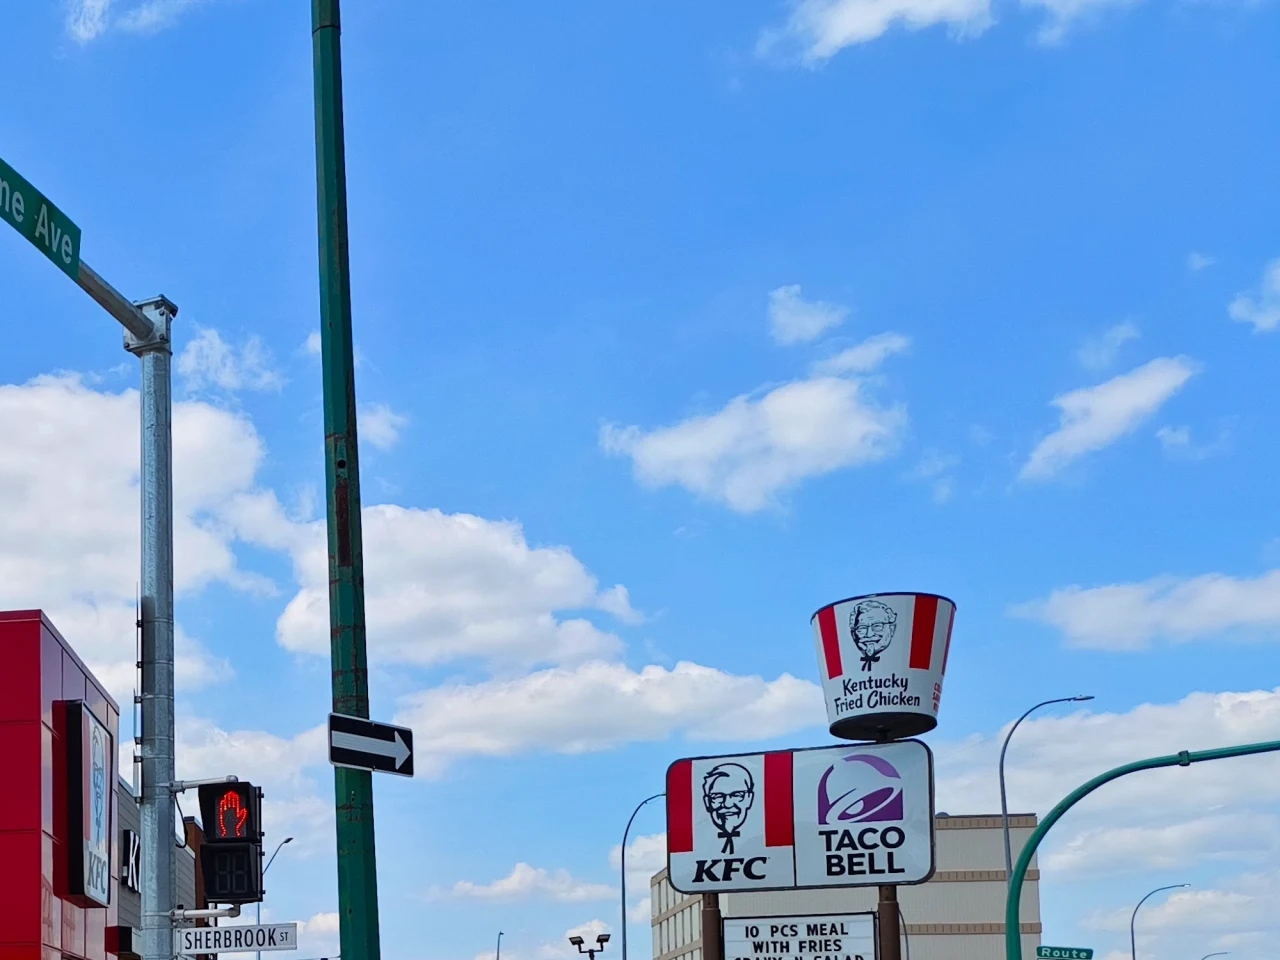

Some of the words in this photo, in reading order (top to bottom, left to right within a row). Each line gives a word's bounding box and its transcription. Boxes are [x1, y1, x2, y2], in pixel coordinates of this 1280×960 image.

[34, 203, 73, 264] Ave
[842, 672, 909, 697] Kentucky
[834, 693, 863, 716] Fried
[867, 689, 921, 709] Chicken
[818, 826, 906, 852] TACO
[87, 850, 107, 896] KFC
[691, 856, 768, 884] KFC
[825, 852, 906, 877] BELL
[184, 928, 277, 950] SHERBROOK
[279, 931, 289, 942] ST
[745, 925, 760, 939] 10
[770, 924, 799, 938] PCS
[806, 922, 849, 937] MEAL
[752, 940, 790, 954] WITH
[798, 939, 843, 953] FRIES
[1041, 947, 1087, 959] Route
